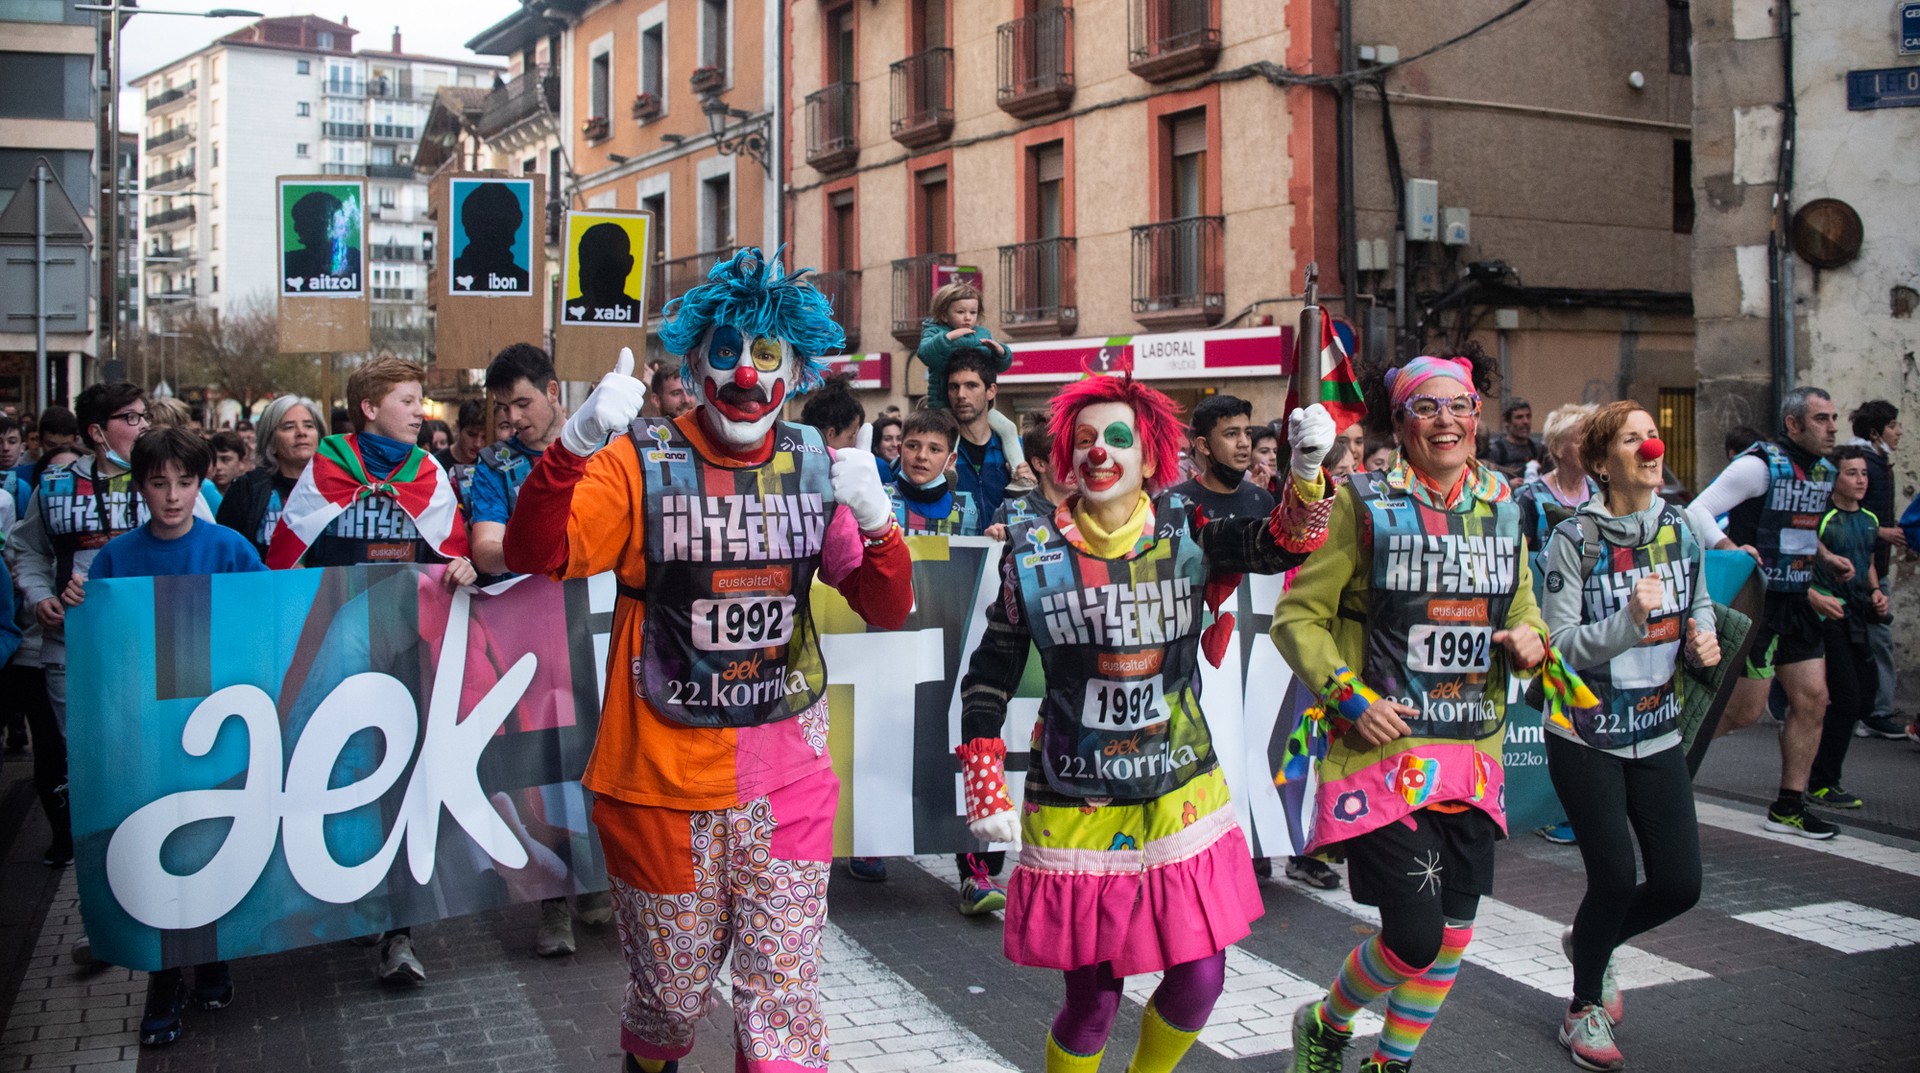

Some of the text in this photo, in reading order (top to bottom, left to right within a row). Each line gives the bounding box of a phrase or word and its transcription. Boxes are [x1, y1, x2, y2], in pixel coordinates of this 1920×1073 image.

[309, 272, 357, 290] aitzol
[488, 272, 518, 290] ibon
[593, 303, 632, 321] xabi
[1142, 341, 1196, 358] LABORAL
[718, 574, 772, 588] euskaltel
[706, 600, 783, 643] 1992
[1432, 606, 1476, 618] euskaltel
[1424, 631, 1486, 666] 1992
[722, 652, 762, 680] aek
[1102, 654, 1148, 673] euskaltel
[1430, 676, 1463, 699] aek
[1097, 682, 1160, 725] 1992
[1103, 733, 1140, 756] aek
[106, 588, 538, 929] aek
[1502, 751, 1543, 766] 022ko
